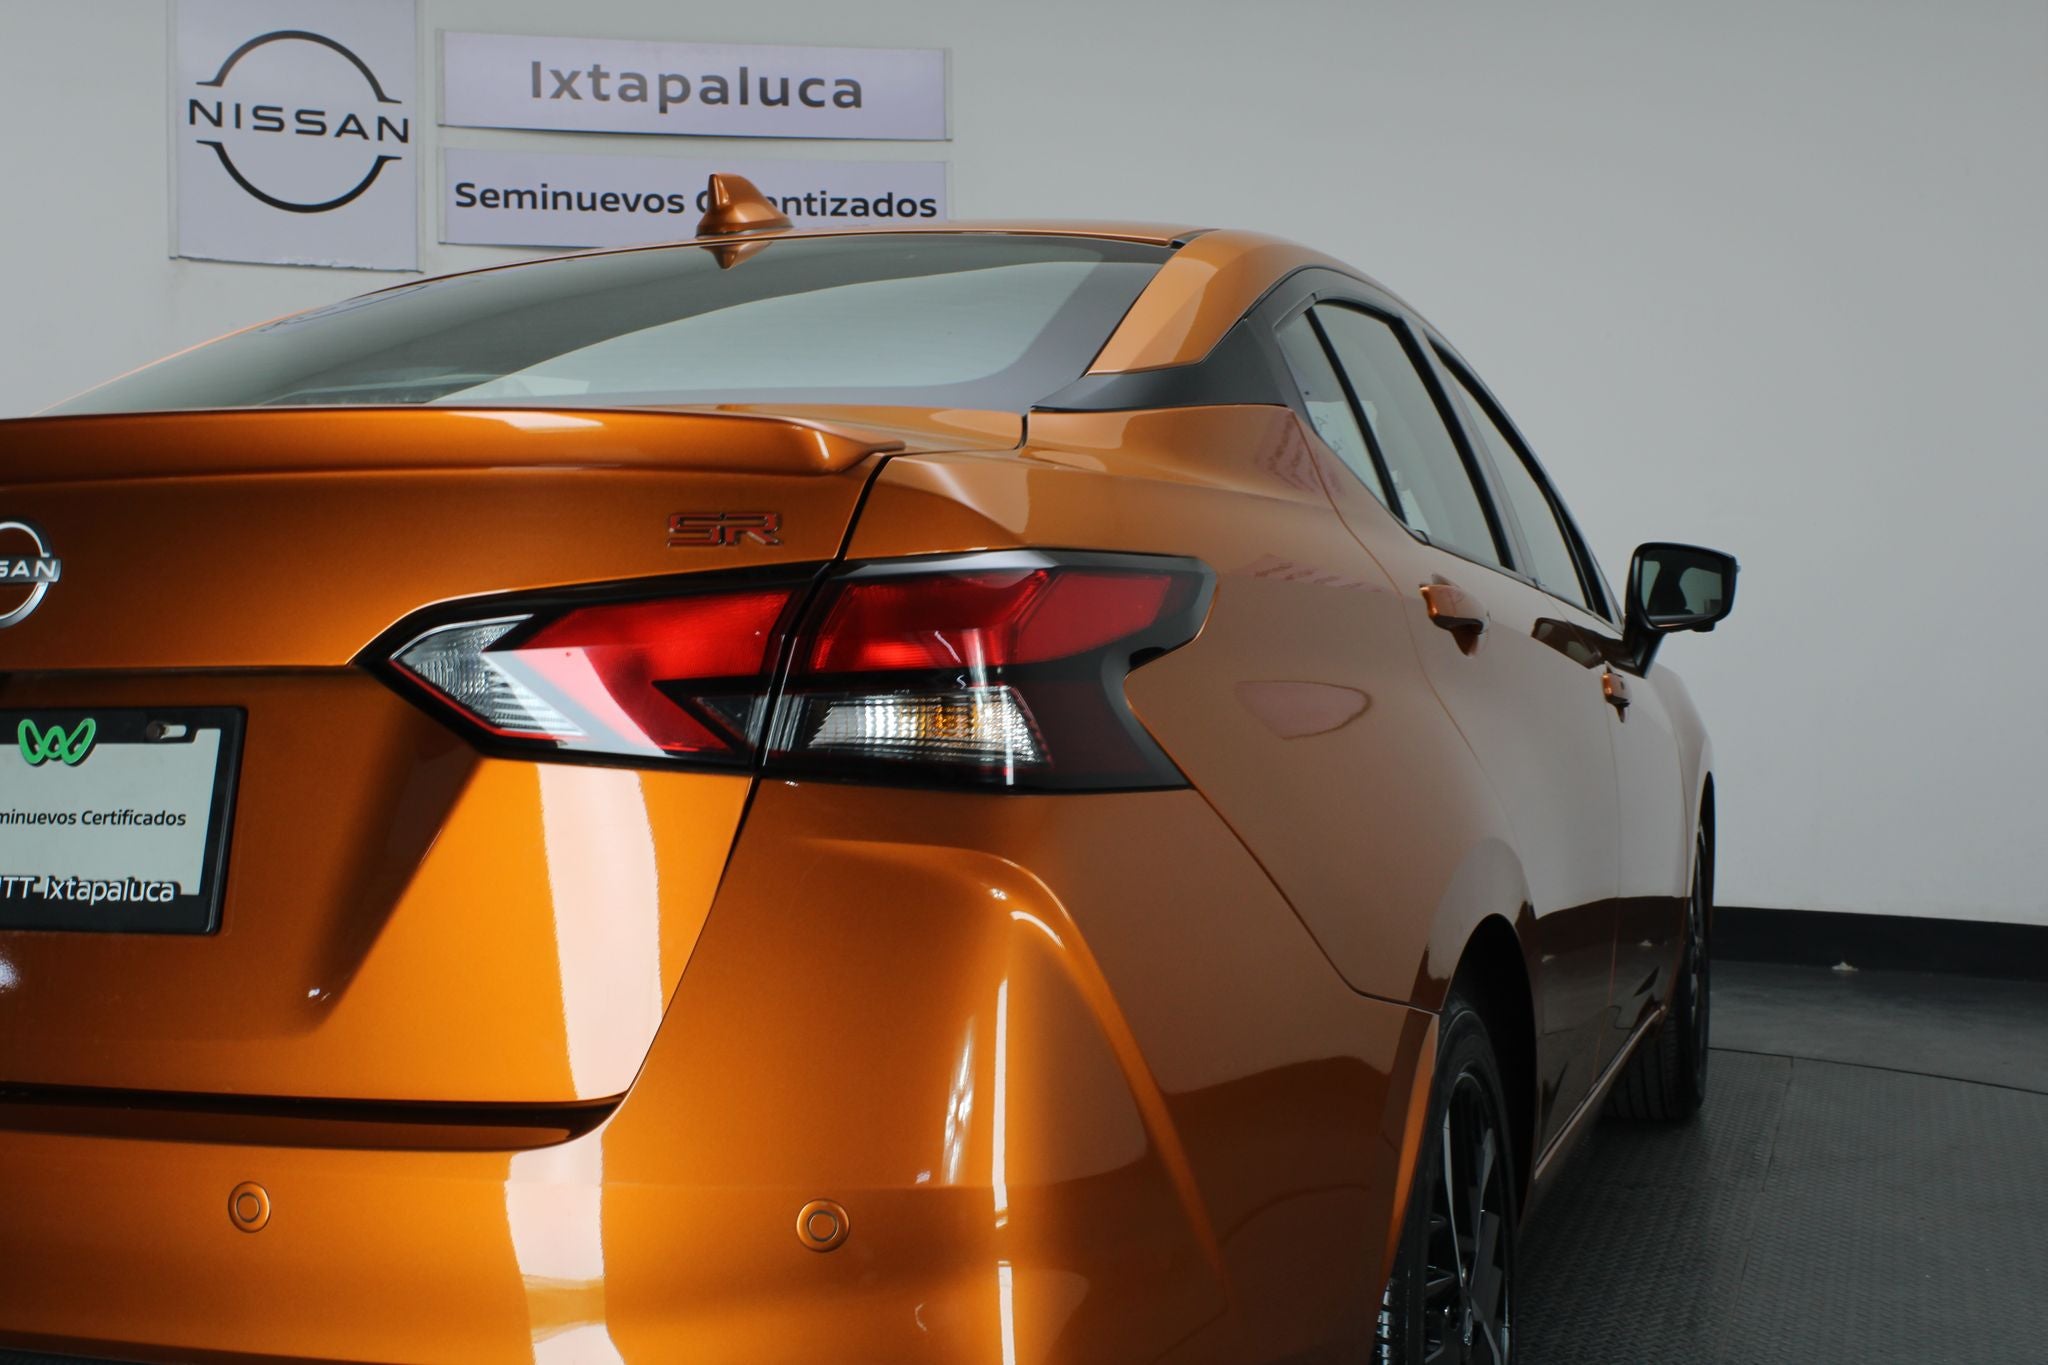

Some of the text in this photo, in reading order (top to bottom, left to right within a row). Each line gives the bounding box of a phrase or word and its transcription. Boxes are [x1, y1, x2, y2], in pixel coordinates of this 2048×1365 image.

[531, 61, 862, 114] Ixtapaluca
[189, 99, 409, 144] NISSAN
[455, 182, 685, 214] Seminuevos
[668, 513, 782, 547] SR
[81, 808, 187, 827] Certificados
[0, 876, 175, 906] TT Ixtapaluca
